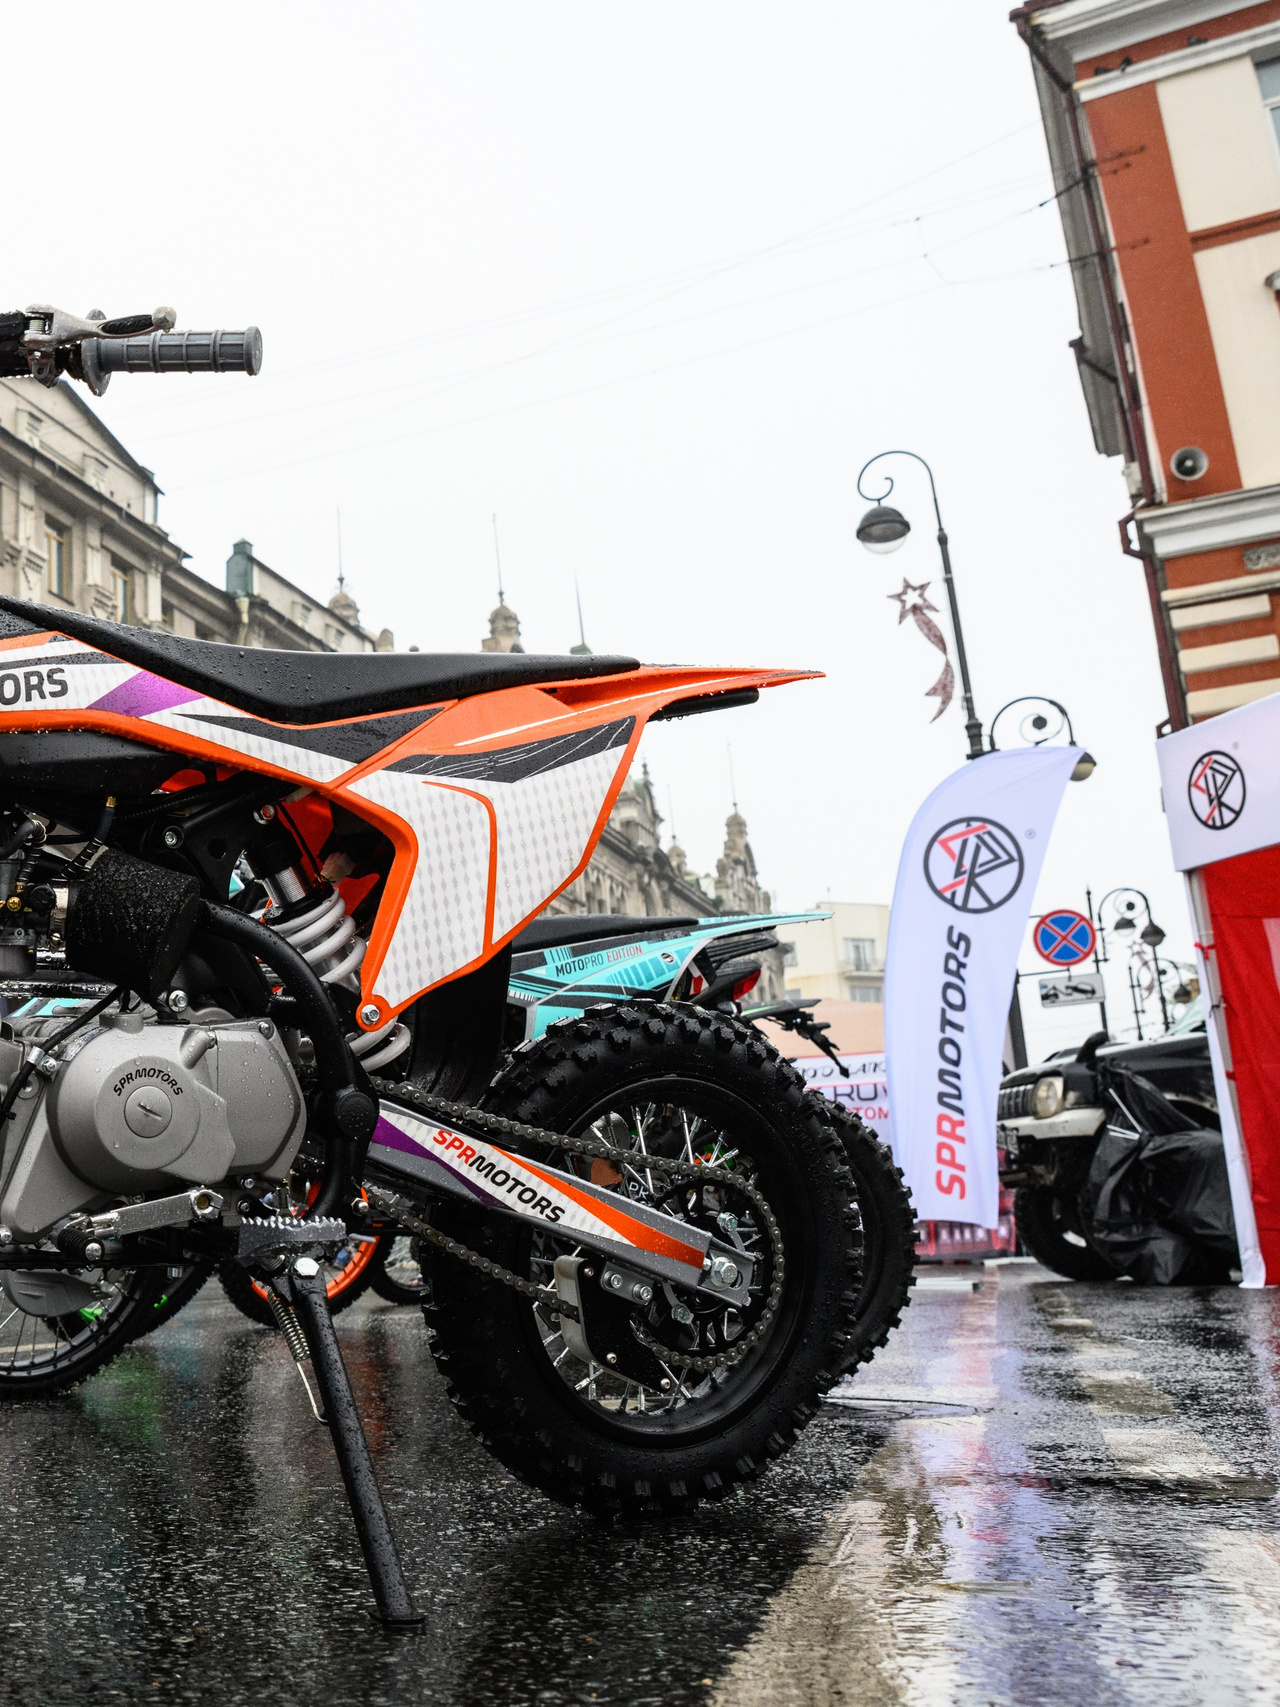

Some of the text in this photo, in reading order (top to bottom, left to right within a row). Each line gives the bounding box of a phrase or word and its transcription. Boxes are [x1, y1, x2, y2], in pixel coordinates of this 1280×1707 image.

[606, 944, 643, 963] EDITION
[113, 1067, 184, 1097] SPRMOTORS
[935, 924, 972, 1200] SPRMOTORS
[432, 1129, 566, 1223] SPRMOTORS
